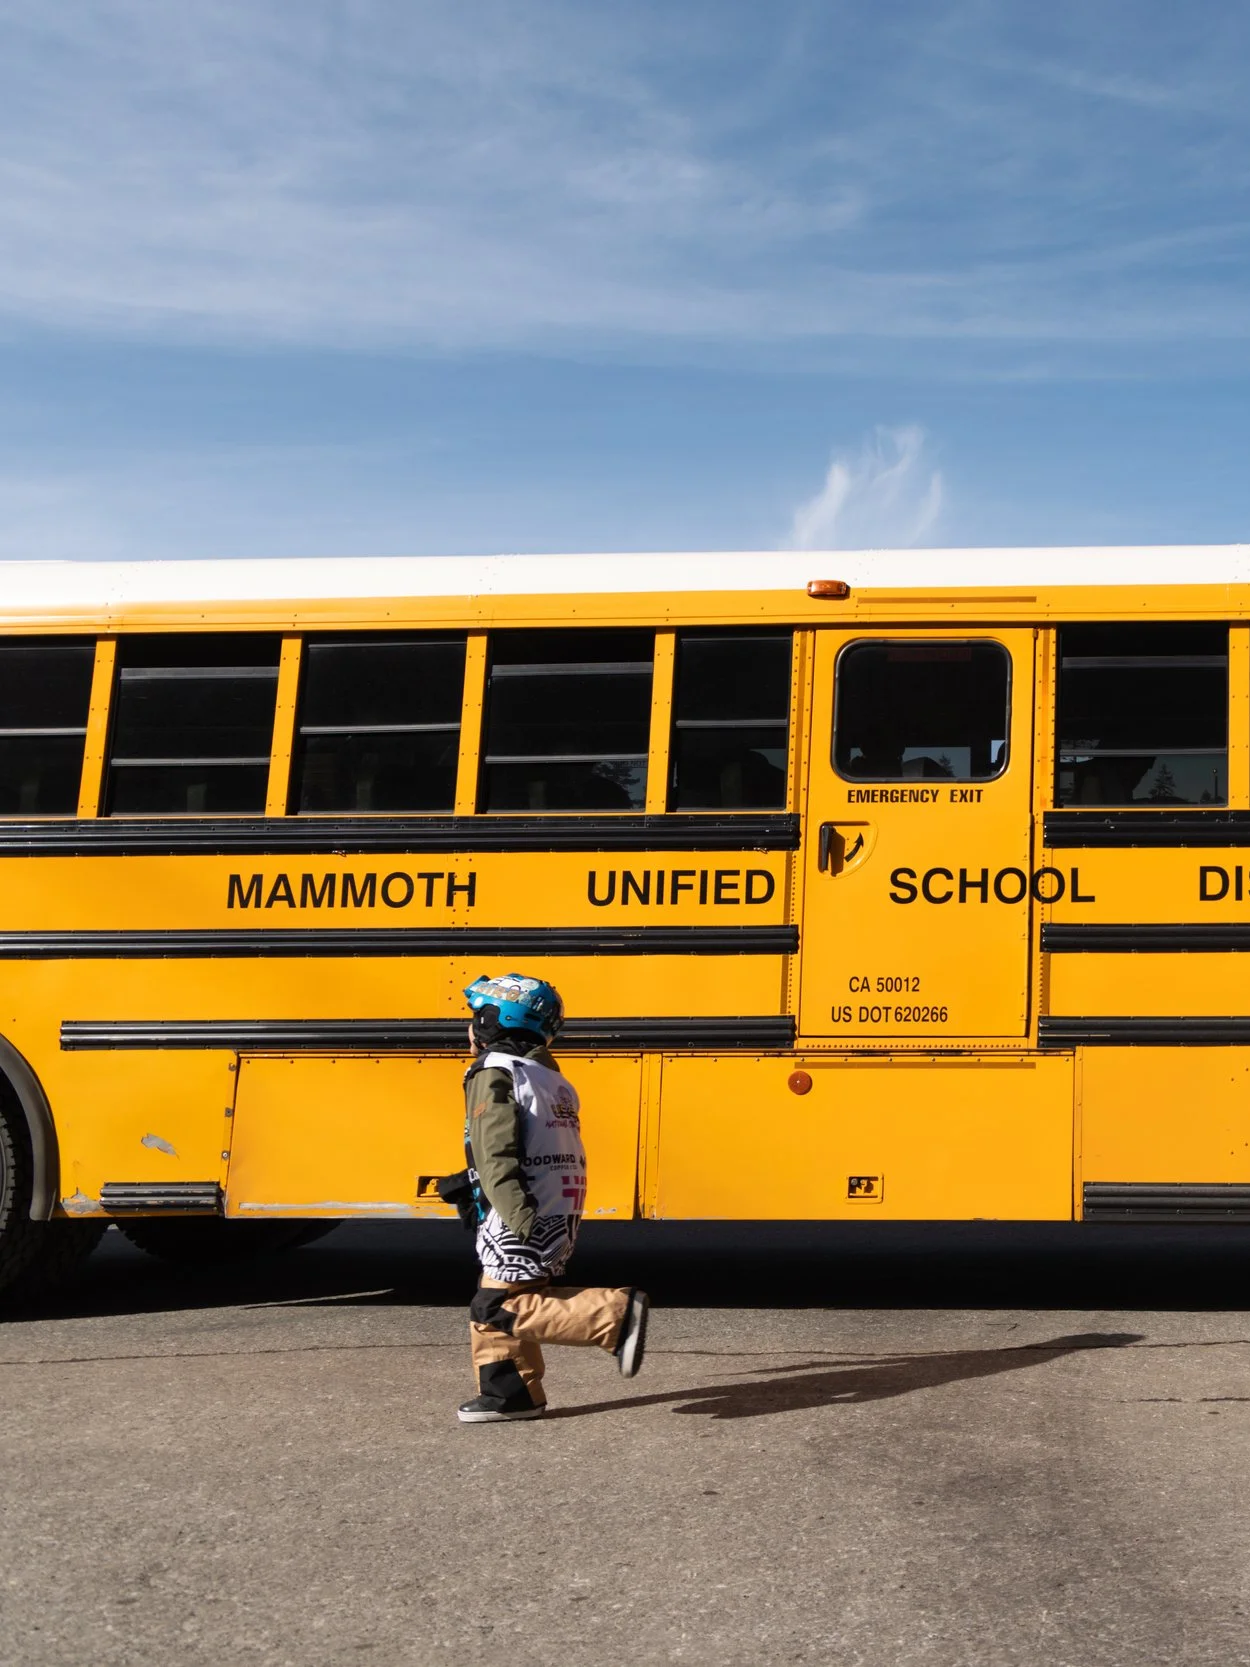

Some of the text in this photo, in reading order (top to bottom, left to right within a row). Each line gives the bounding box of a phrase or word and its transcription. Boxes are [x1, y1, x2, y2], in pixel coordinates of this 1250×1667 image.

[847, 789, 983, 803] EMERGENCY EXIT
[227, 872, 476, 908] MAMMOTH
[587, 870, 775, 906] UNIFIED
[889, 866, 1095, 904] SCHOOL
[848, 976, 920, 992] CA 50012
[831, 1006, 948, 1023] US DOT 620266
[519, 1153, 576, 1167] OODWARD
